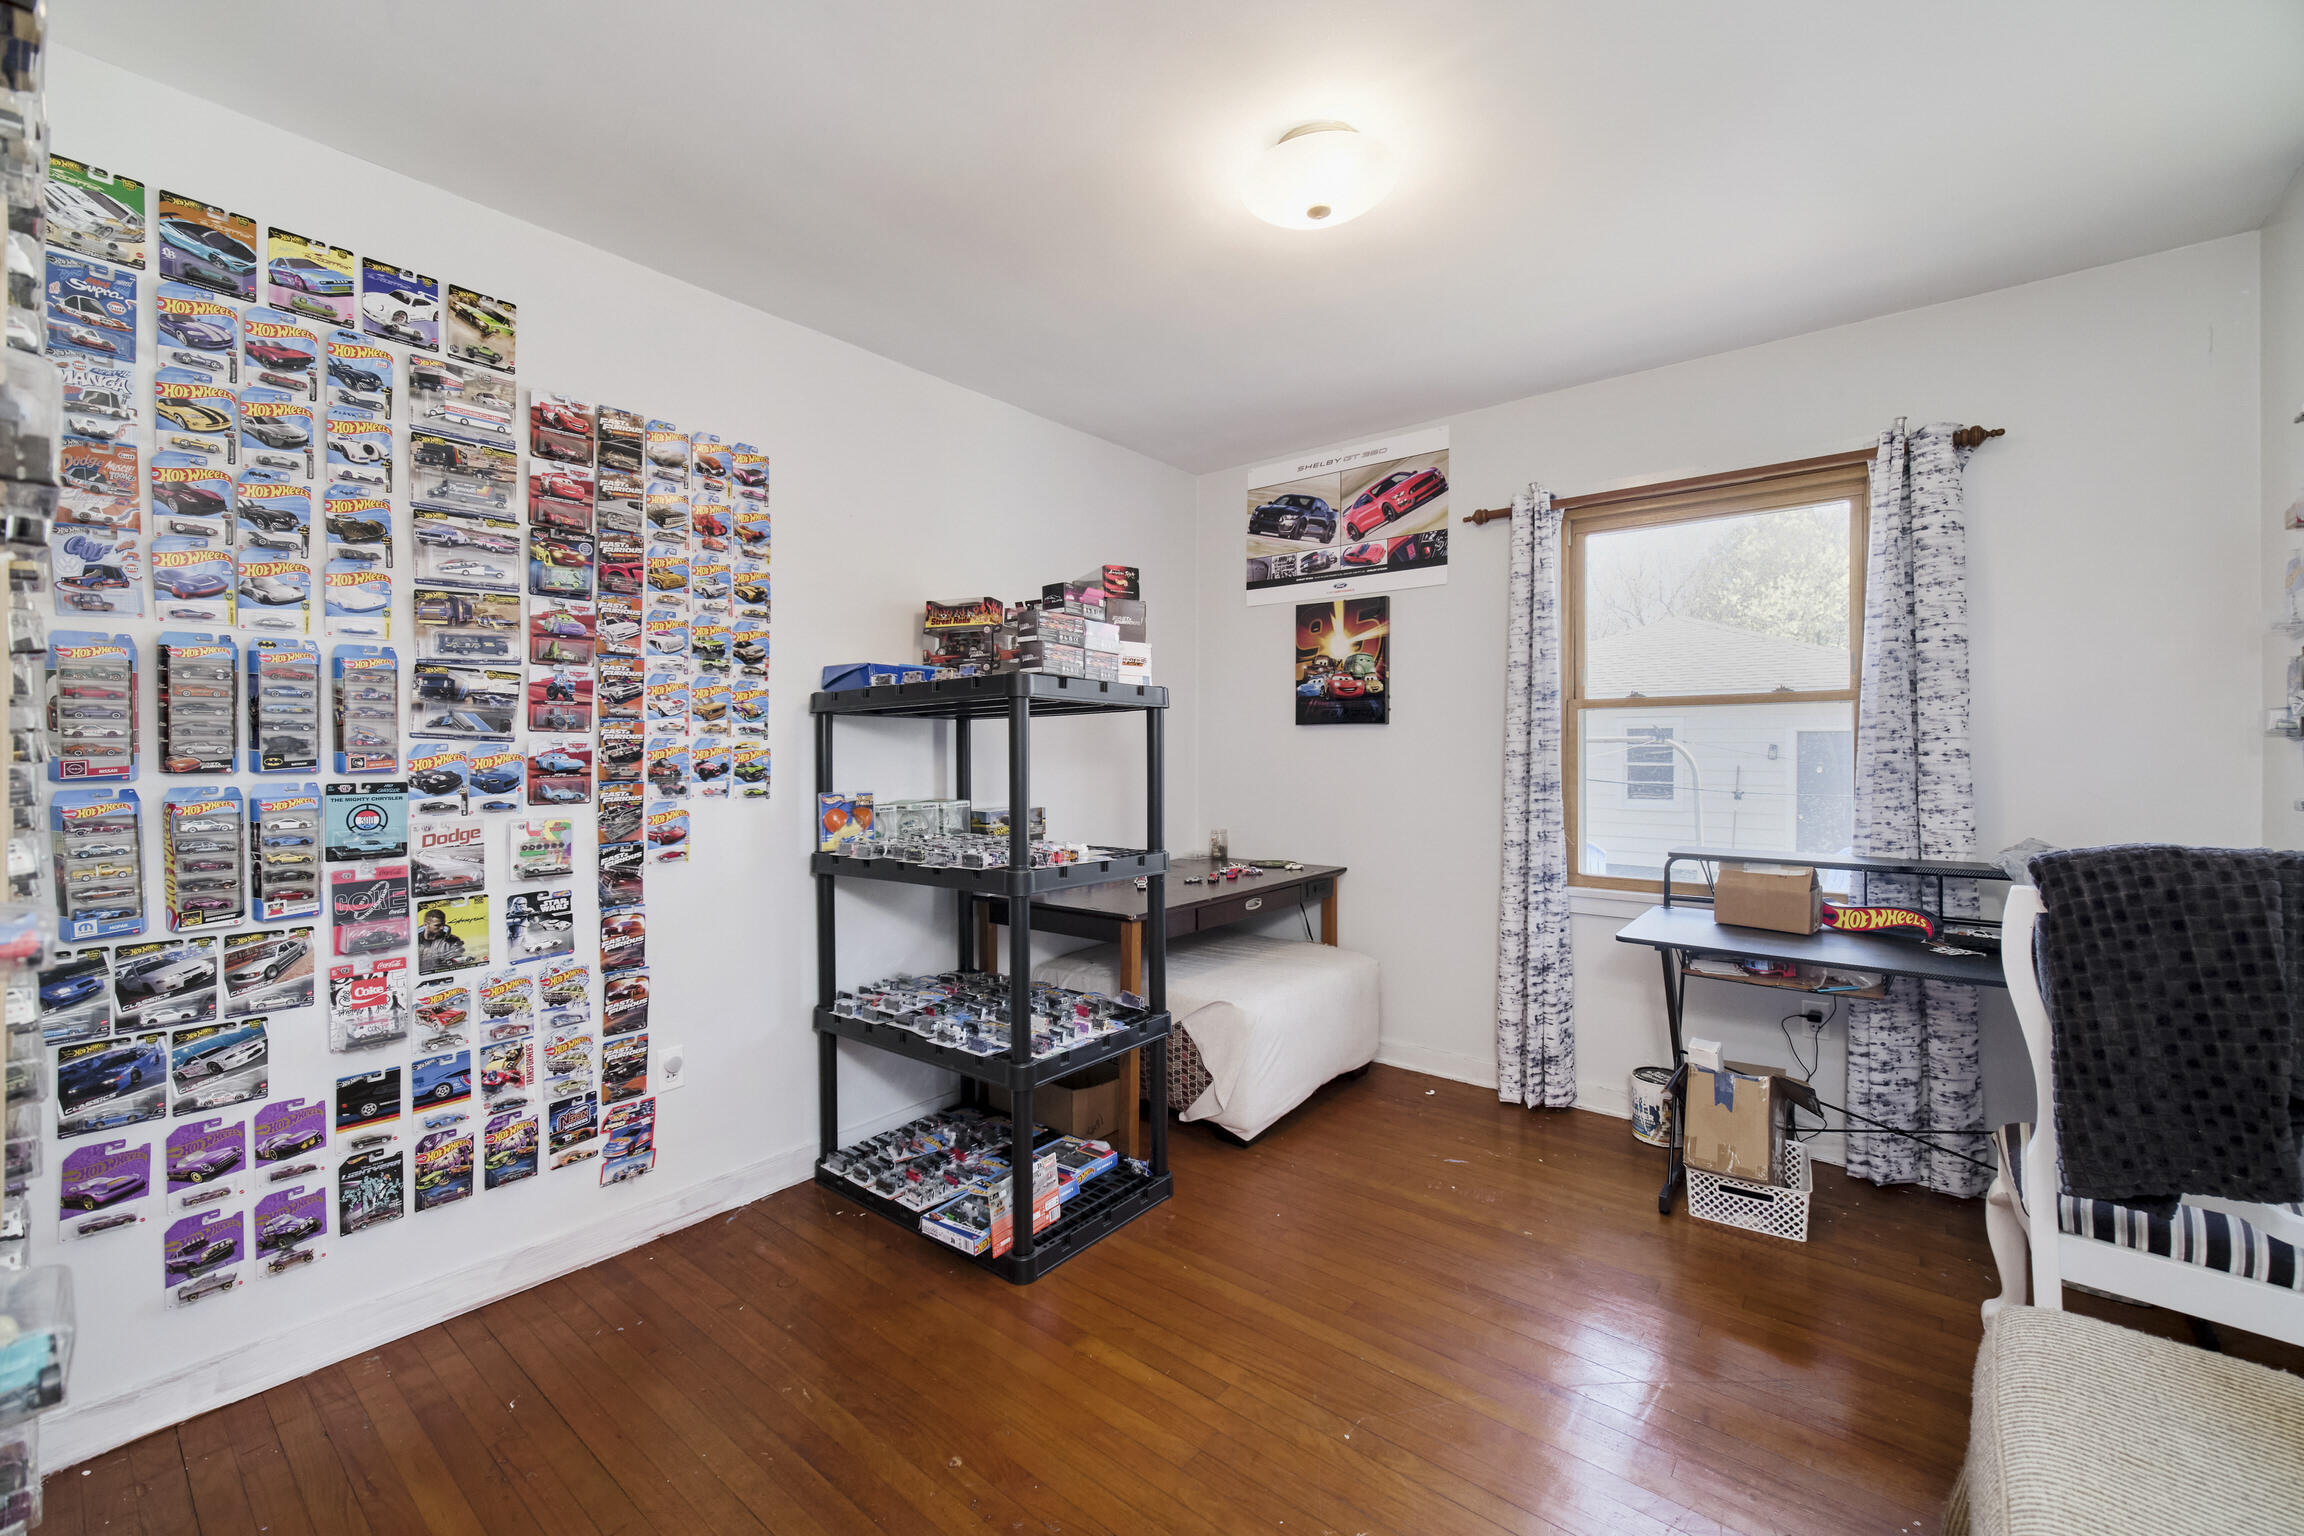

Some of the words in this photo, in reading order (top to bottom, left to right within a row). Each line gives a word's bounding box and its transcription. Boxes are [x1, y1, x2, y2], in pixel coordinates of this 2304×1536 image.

[66, 278, 124, 300] Supra
[164, 300, 193, 314] HOT
[251, 323, 277, 337] HOT
[334, 344, 360, 357] HOT
[164, 384, 190, 398] HOT
[248, 402, 271, 416] HOT
[333, 421, 357, 433] HOT
[61, 454, 104, 470] Dodge
[1297, 458, 1341, 472] SHELBY
[161, 468, 186, 482] HOT
[244, 485, 268, 497] HOT
[331, 500, 354, 513] HOT
[161, 551, 186, 565] HOT
[244, 563, 268, 577] HOT
[331, 574, 354, 587] HOT
[931, 617, 952, 625] Street
[72, 648, 92, 658] HOT
[181, 648, 201, 658] HOT
[414, 758, 432, 771] HOT
[475, 757, 494, 769] HOT
[77, 808, 96, 819] HOT
[183, 805, 202, 815] HOT
[422, 828, 481, 848] Dodge
[540, 903, 569, 912] WARS
[543, 898, 569, 907] STAR
[1833, 909, 1868, 929] HOT
[354, 985, 384, 998] Coke
[122, 992, 171, 1011] CLASSICS
[526, 1043, 534, 1086] TRANSFORMERS
[65, 1092, 117, 1115] CLASSICS
[427, 1149, 442, 1162] HOT
